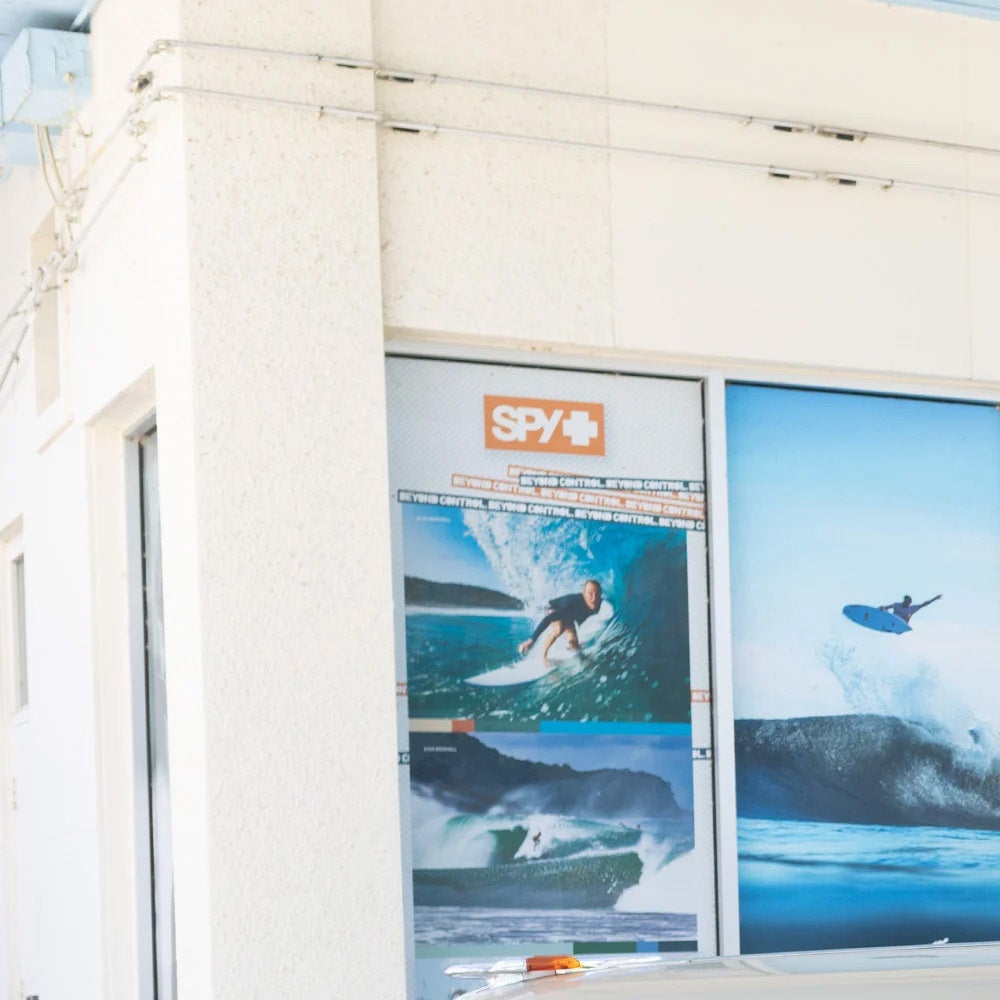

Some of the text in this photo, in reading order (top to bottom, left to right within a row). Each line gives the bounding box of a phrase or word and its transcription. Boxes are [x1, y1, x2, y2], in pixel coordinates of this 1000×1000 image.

[520, 475, 558, 488] BEYOND
[606, 478, 643, 490] BEYOND
[399, 491, 438, 505] BEYOND
[488, 499, 527, 514] BEYOND
[575, 508, 612, 522] BEYOND
[659, 516, 695, 530] BEYOND
